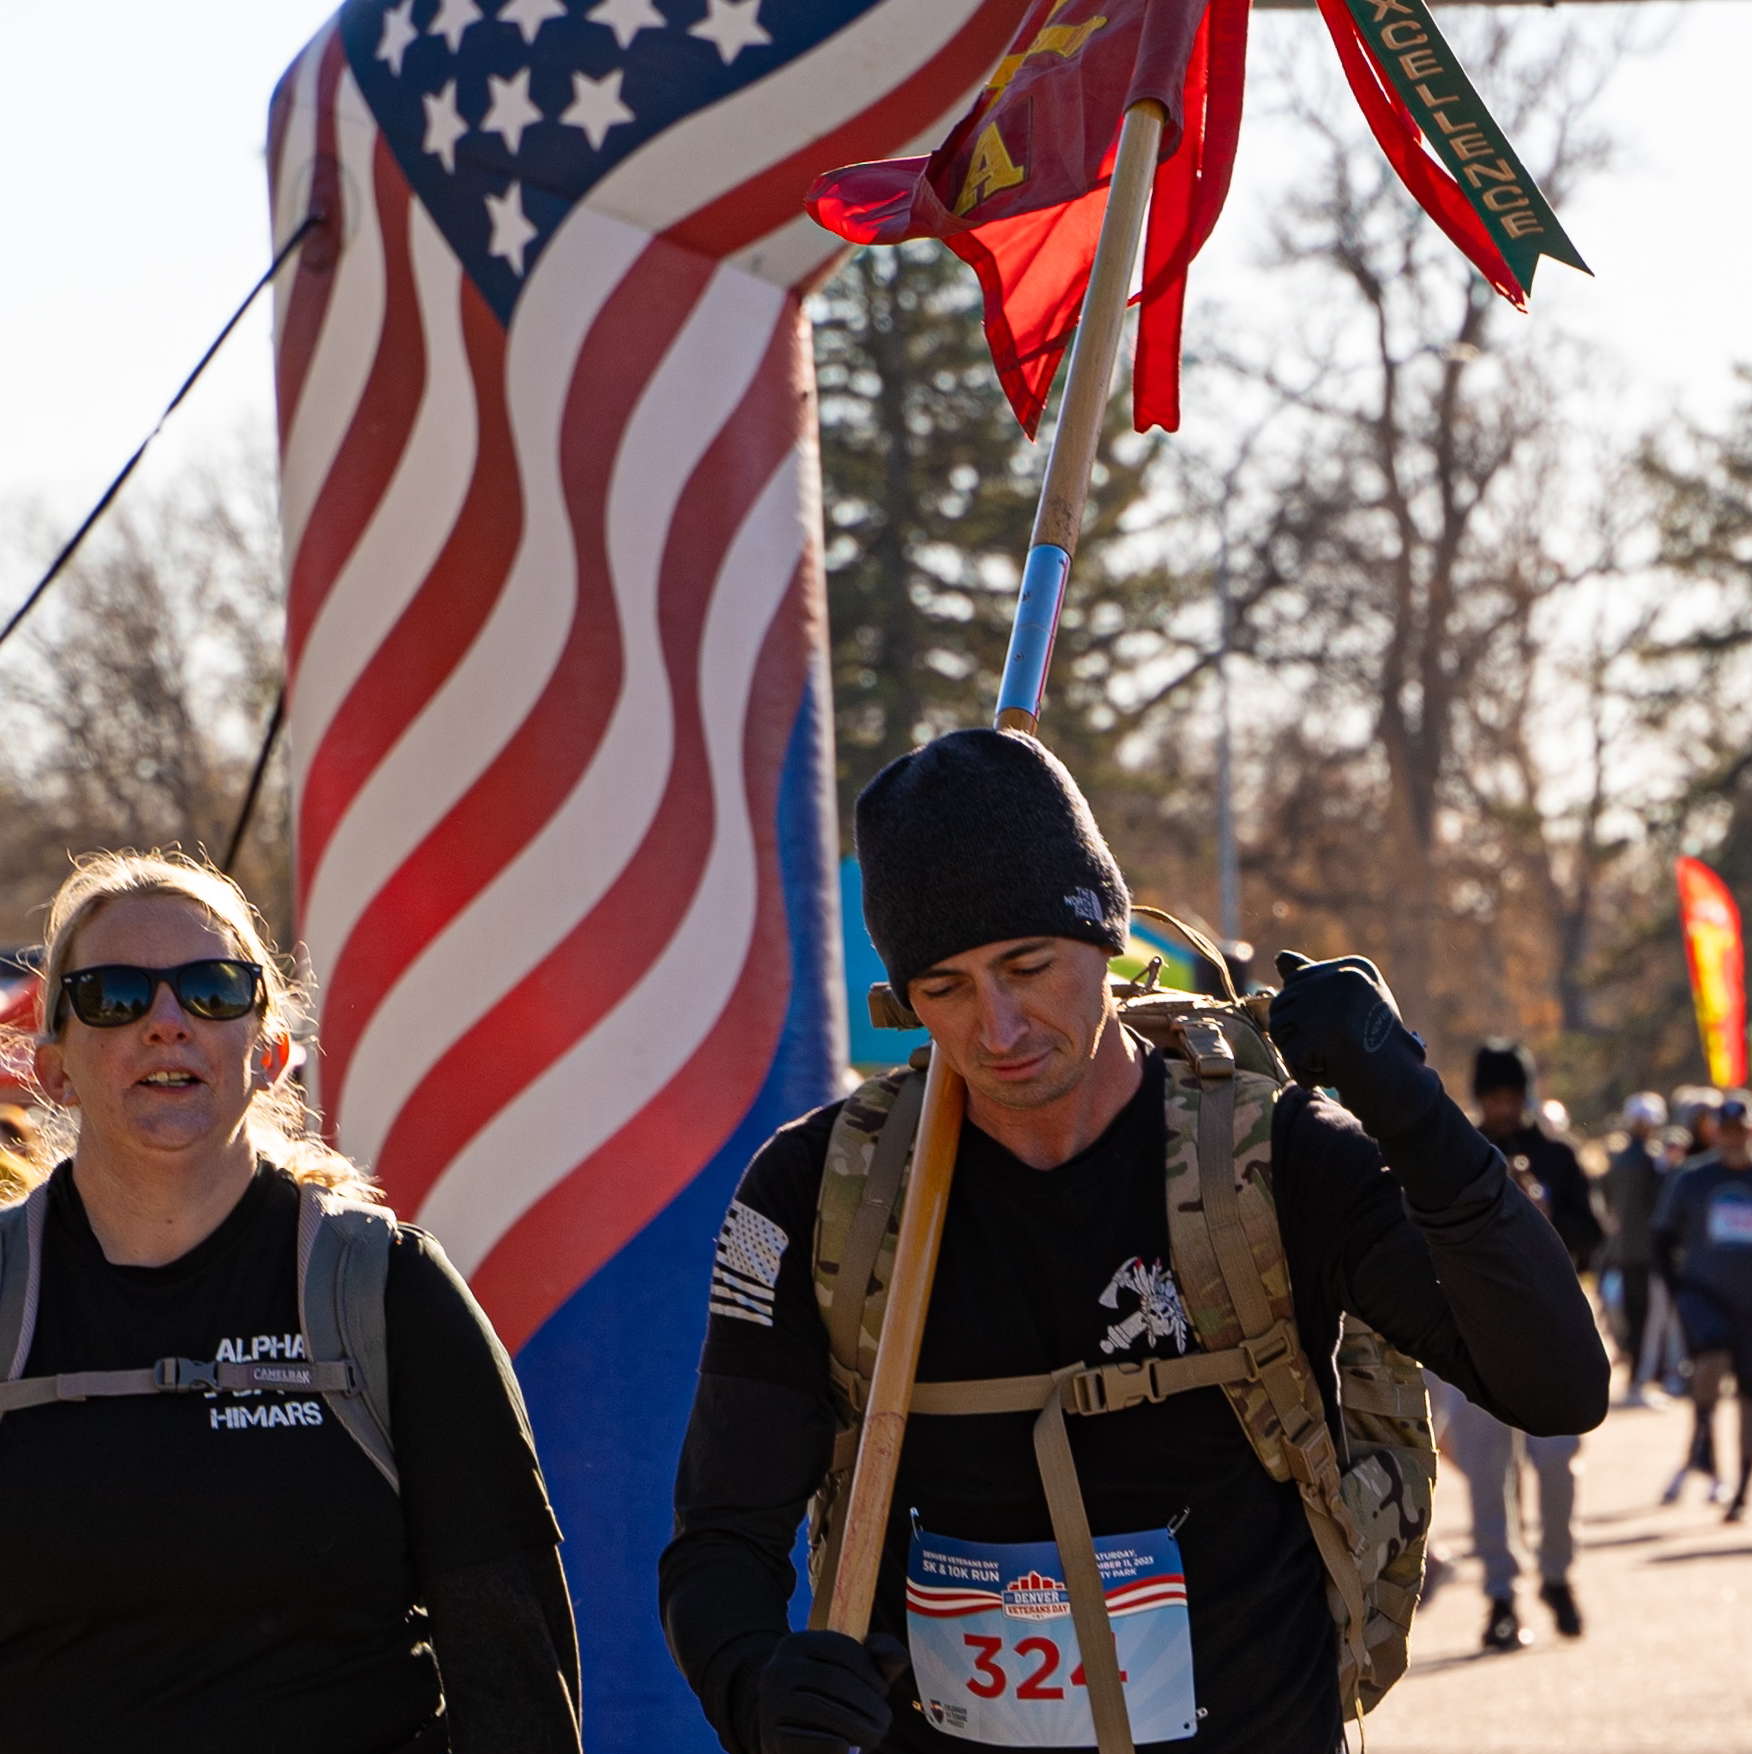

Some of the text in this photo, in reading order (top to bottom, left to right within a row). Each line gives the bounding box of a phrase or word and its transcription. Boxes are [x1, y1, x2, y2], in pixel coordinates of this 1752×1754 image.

[1366, 0, 1544, 239] XCELLENCE
[216, 1333, 306, 1363] ALPHA
[209, 1401, 323, 1430] HIMARS
[1095, 1550, 1138, 1561] ATURDAY,
[923, 1560, 999, 1582] 5K & 10K RUN
[1014, 1592, 1060, 1604] DENVER
[1007, 1604, 1069, 1615] VETERANS DAY
